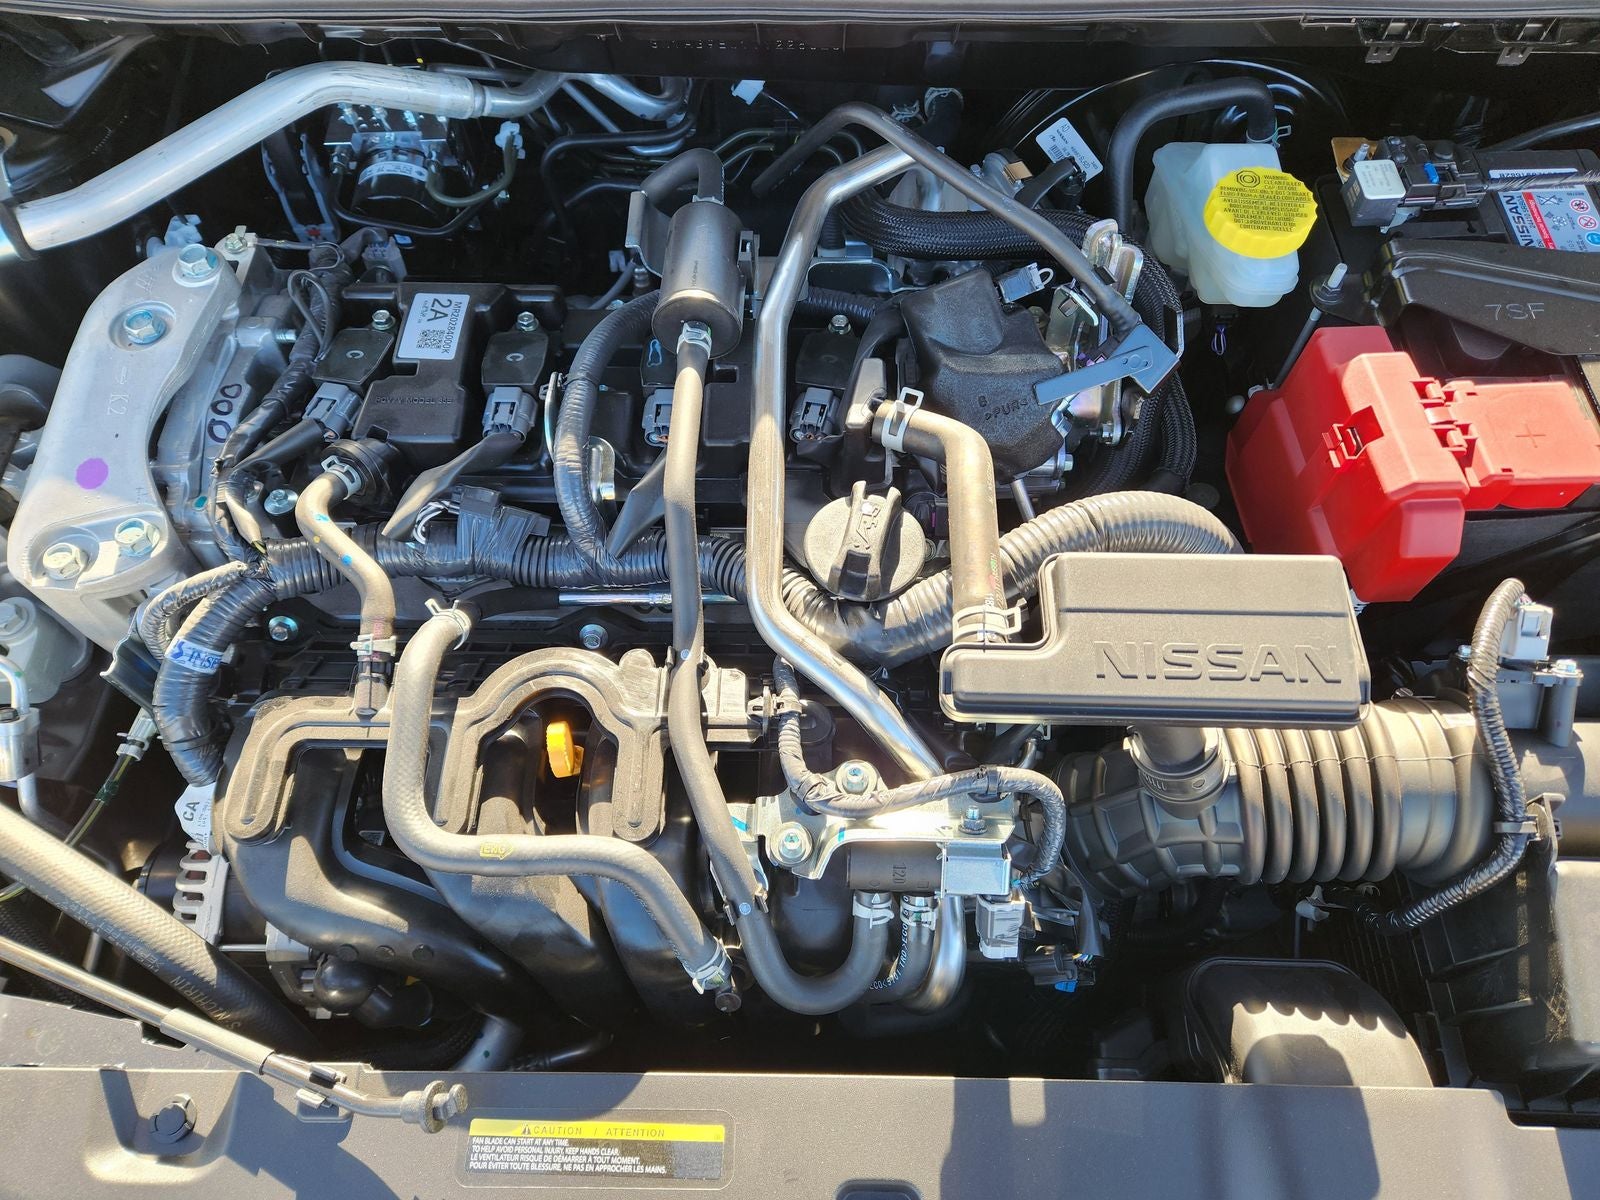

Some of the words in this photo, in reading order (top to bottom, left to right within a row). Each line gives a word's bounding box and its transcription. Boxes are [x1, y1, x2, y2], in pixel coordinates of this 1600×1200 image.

[1503, 195, 1534, 247] NISSAN
[427, 298, 452, 322] 2A
[1484, 303, 1544, 320] 7SF
[1094, 641, 1341, 683] NISSAN
[182, 802, 200, 822] CA
[170, 976, 232, 1021] NICHIRIN
[534, 1126, 582, 1134] CAUTION
[606, 1128, 665, 1137] ATTENTION
[496, 1146, 514, 1154] AVOID
[514, 1146, 543, 1154] PERSONAL
[553, 1154, 587, 1162] DÉMARRER
[488, 1161, 508, 1170] ÉVITER
[596, 1164, 632, 1172] APPROCHER
[644, 1166, 666, 1174] MAINS.
